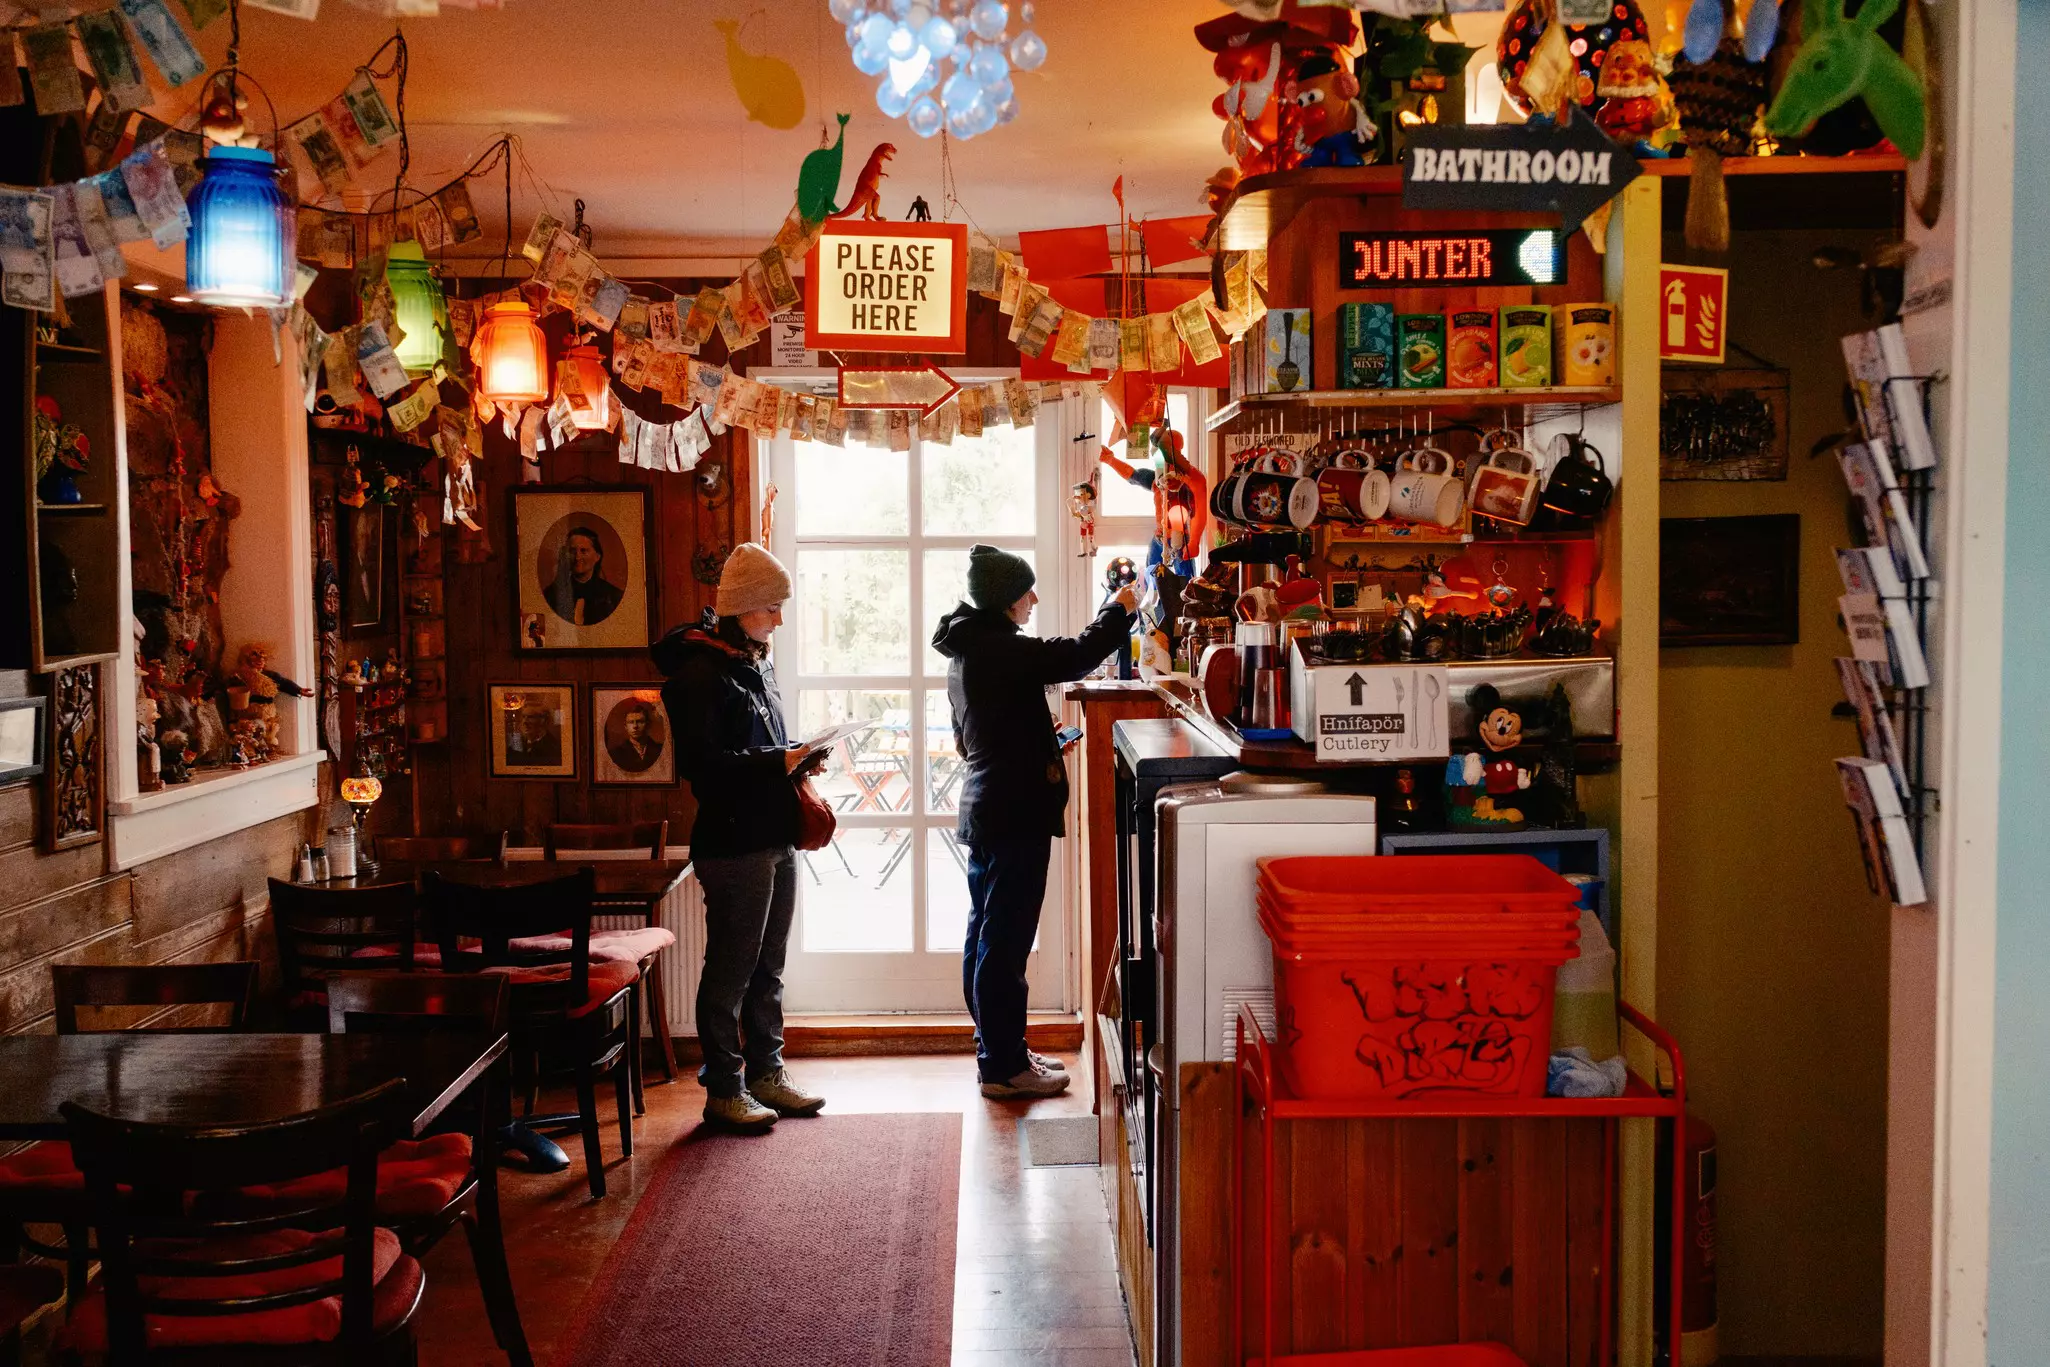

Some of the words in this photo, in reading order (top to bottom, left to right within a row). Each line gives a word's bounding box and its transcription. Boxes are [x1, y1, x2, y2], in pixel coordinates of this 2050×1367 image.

[1411, 148, 1612, 185] BATHROOM
[837, 243, 935, 272] PLEASE
[843, 272, 927, 301] ORDER
[852, 303, 918, 331] HERE
[1353, 360, 1384, 369] MINTS
[1234, 435, 1250, 446] OLD
[1322, 716, 1403, 733] Hnífapör
[1323, 737, 1392, 753] Cutlery
